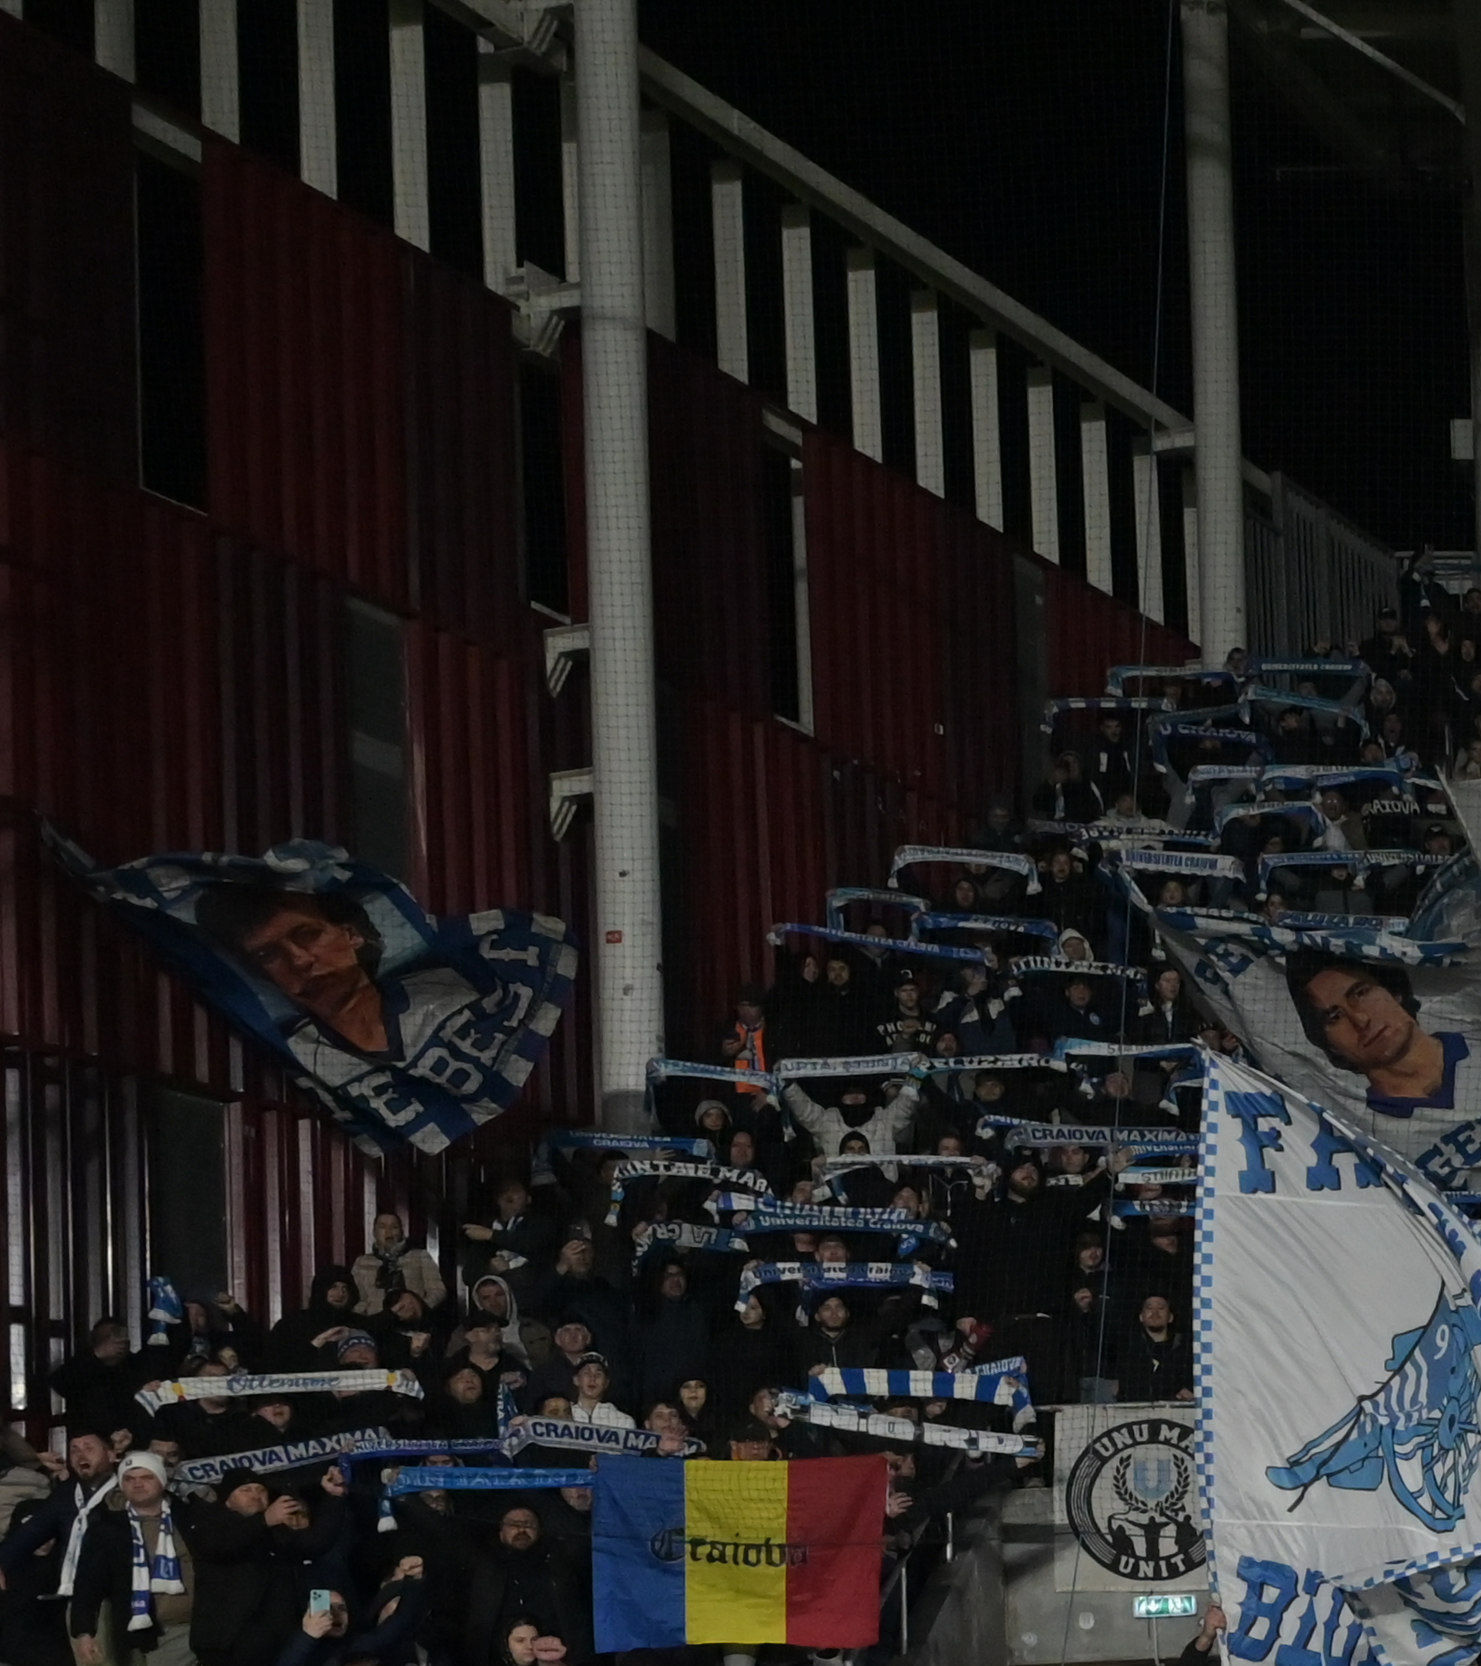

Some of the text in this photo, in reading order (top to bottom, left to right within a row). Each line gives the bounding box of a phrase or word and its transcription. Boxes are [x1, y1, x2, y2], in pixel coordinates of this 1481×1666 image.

[592, 1137, 651, 1150] CRAIOVA
[1031, 1126, 1108, 1146] CRAIOVA
[530, 1419, 622, 1447] CRAIOVA
[1095, 1423, 1150, 1458] UNU
[188, 1447, 284, 1481] CRAIOVA
[1118, 1553, 1186, 1578] UNIT
